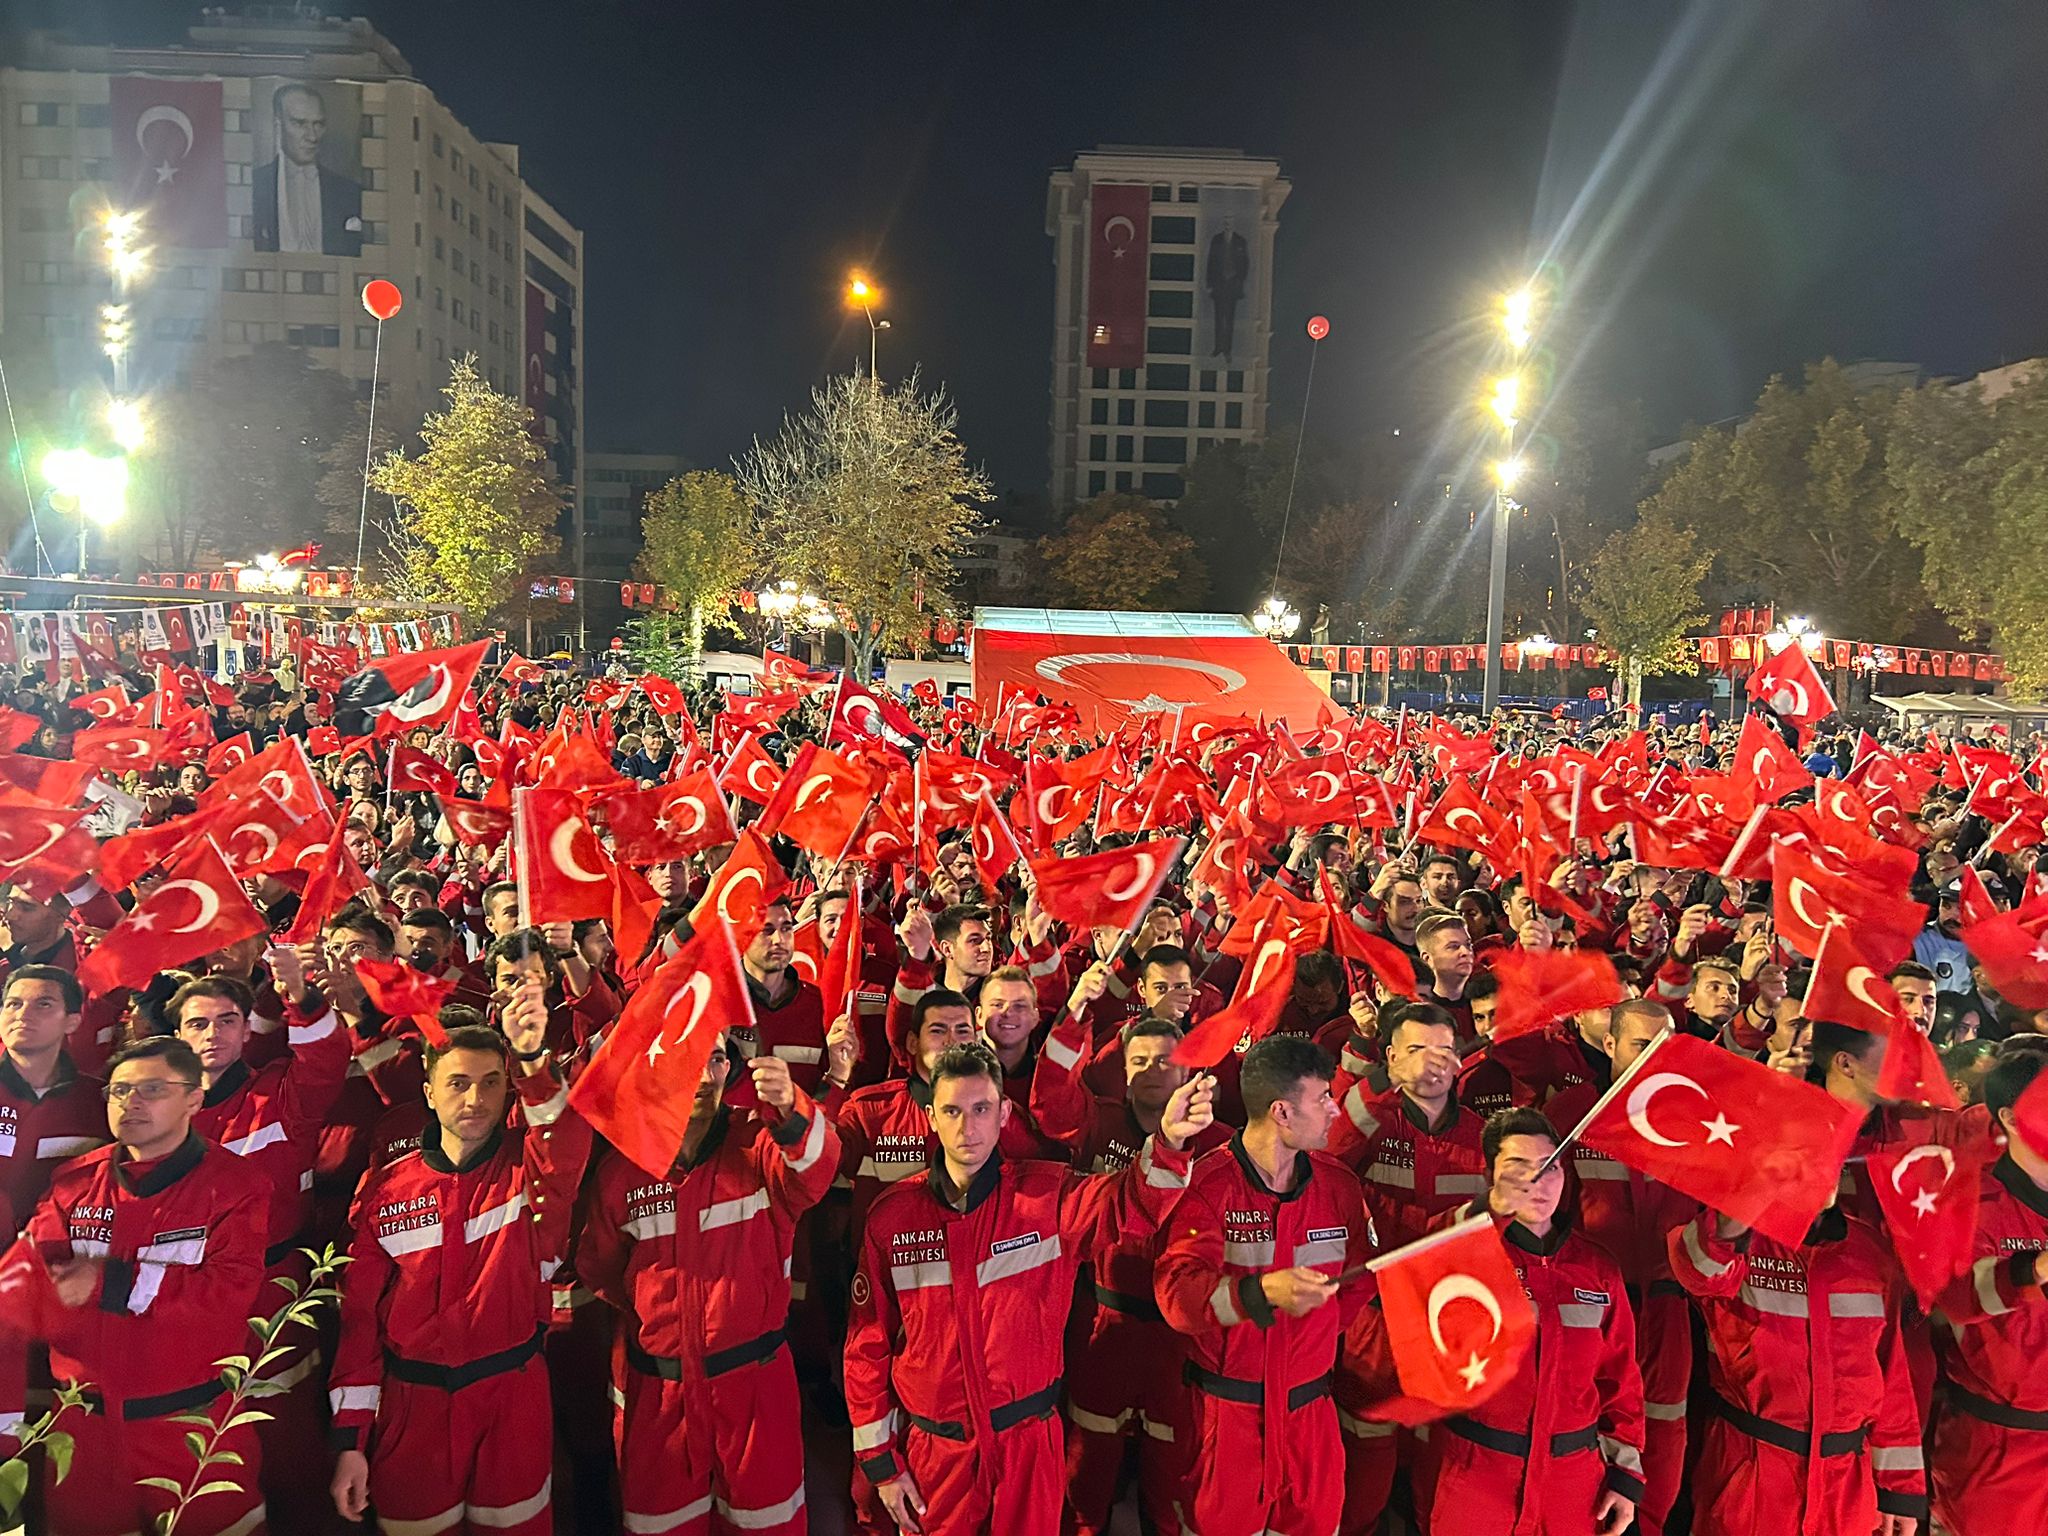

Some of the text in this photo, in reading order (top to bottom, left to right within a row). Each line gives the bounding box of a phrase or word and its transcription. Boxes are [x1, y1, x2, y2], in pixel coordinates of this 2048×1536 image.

[876, 1135, 925, 1146] ANKARA
[379, 1194, 437, 1218] ANKARA
[893, 1229, 944, 1246] ANKARA
[1750, 1255, 1803, 1274] ANKARA
